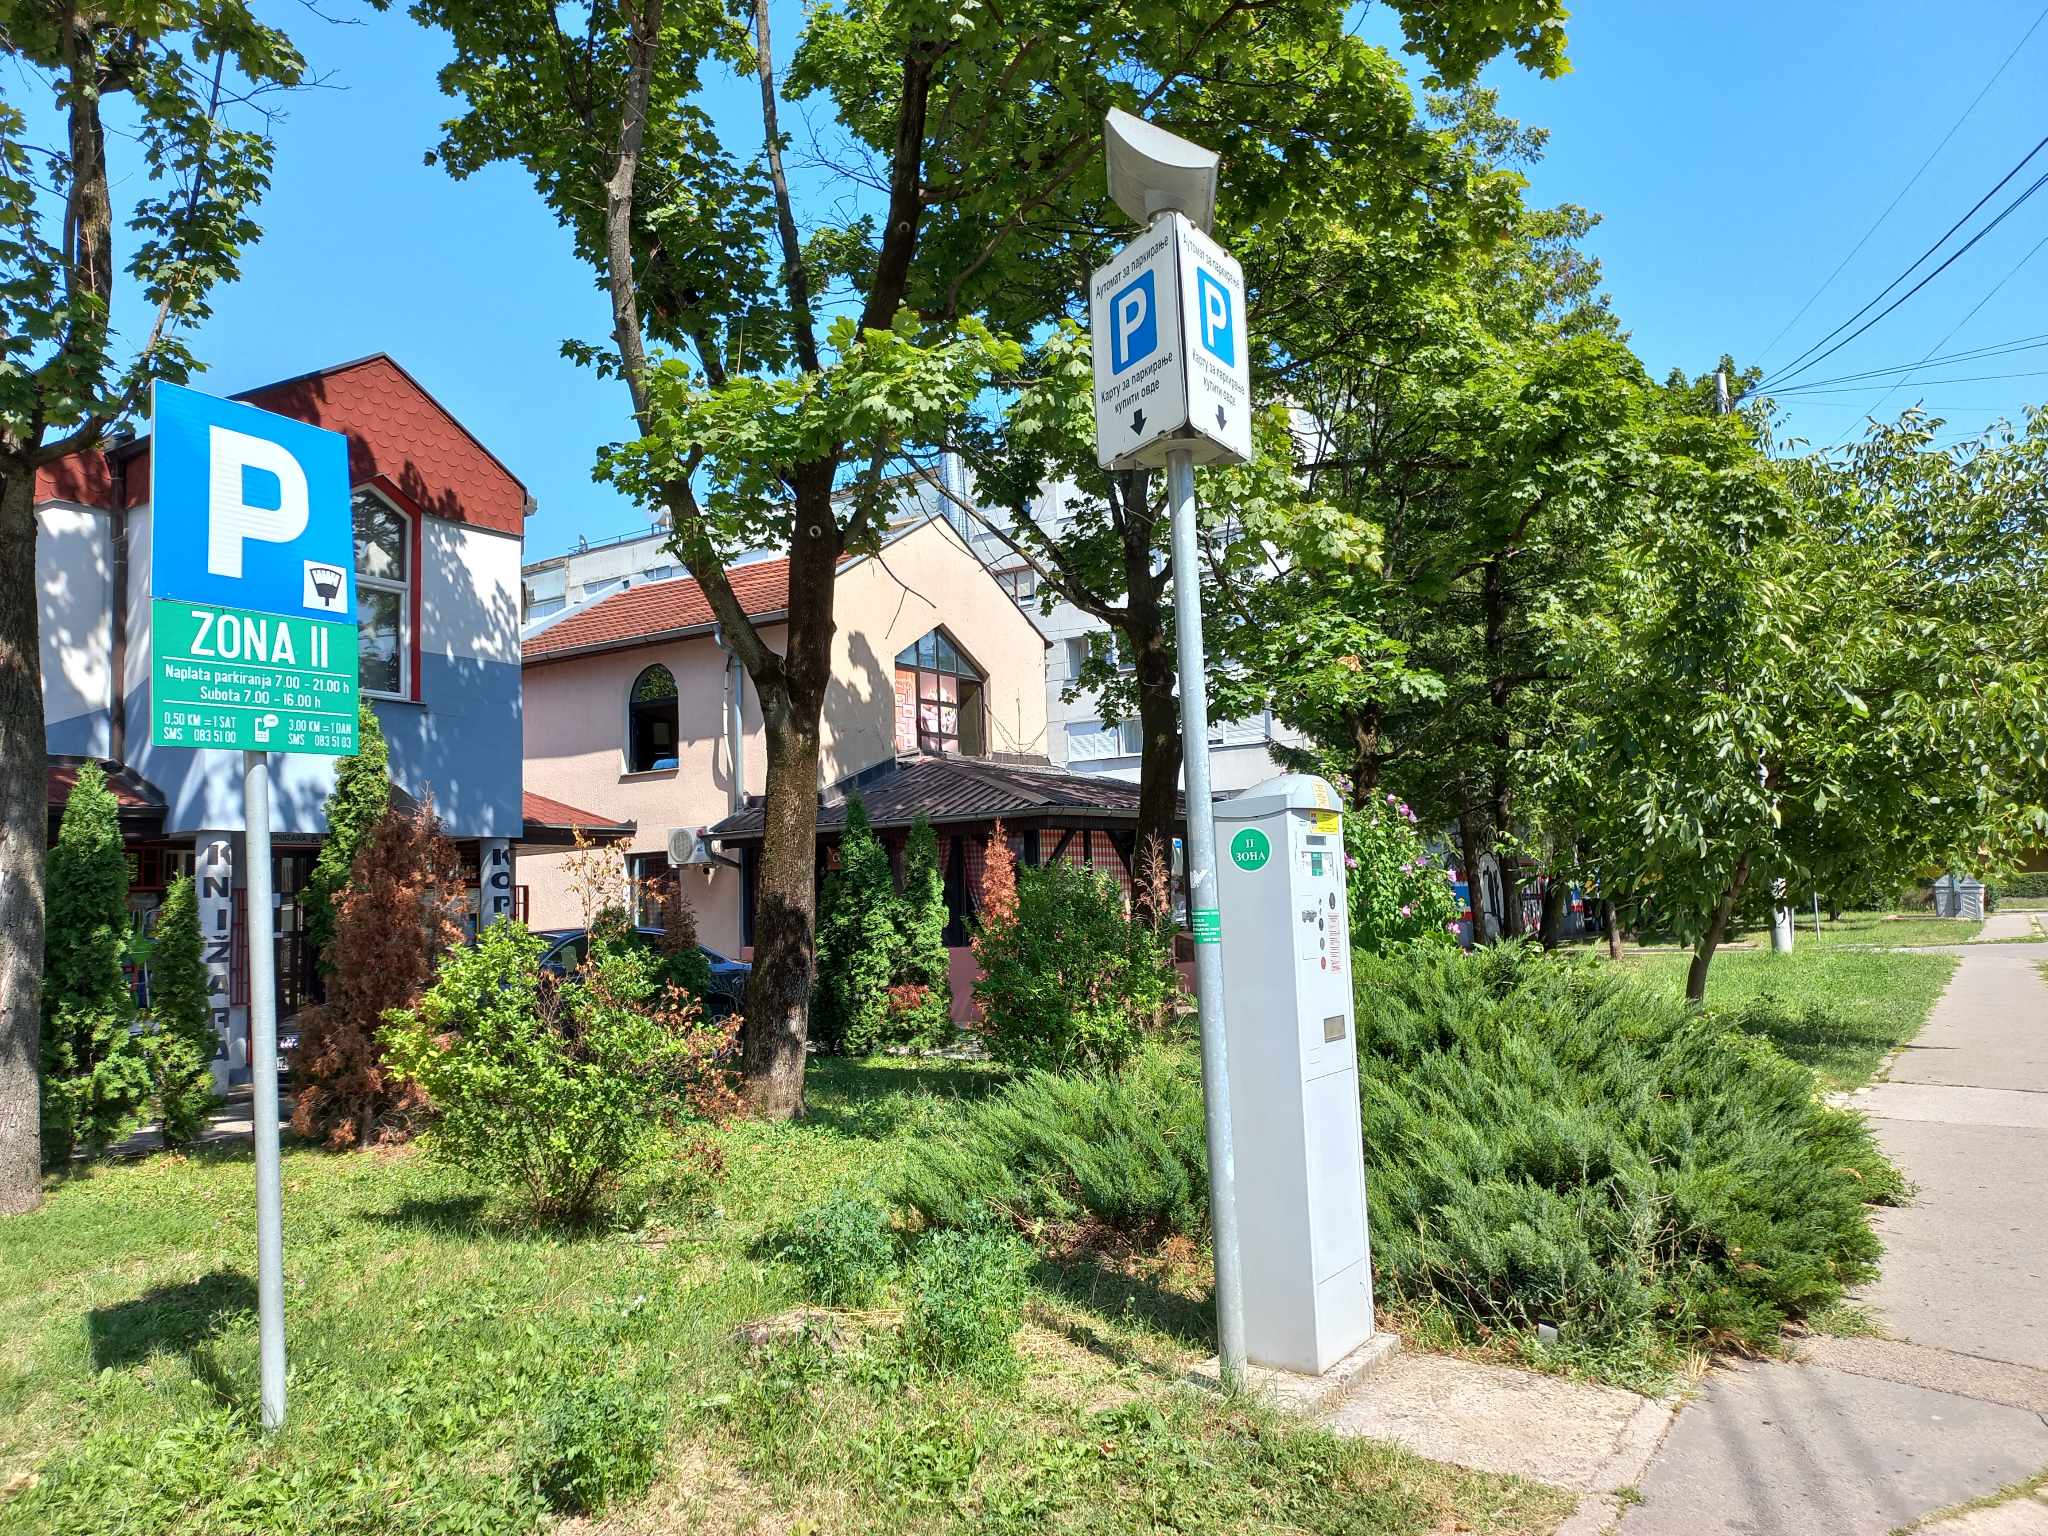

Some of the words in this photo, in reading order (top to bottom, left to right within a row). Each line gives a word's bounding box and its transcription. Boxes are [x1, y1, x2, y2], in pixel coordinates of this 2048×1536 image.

[1096, 272, 1121, 299] Аутомат
[1122, 265, 1130, 279] за
[1131, 235, 1169, 272] паркирање
[1118, 287, 1147, 364] P
[1204, 279, 1227, 348] P
[1101, 385, 1121, 404] Карту
[1122, 378, 1130, 391] за
[1131, 352, 1173, 384] паркирање
[1115, 392, 1140, 414] купити
[1140, 379, 1160, 398] овде
[208, 425, 309, 579] P
[190, 610, 296, 665] ZONA
[310, 625, 329, 669] II
[165, 664, 211, 682] Naplata
[214, 670, 272, 689] parkiranja
[275, 674, 300, 689] 7.00
[312, 678, 340, 693] 21.00
[343, 681, 350, 694] h
[200, 687, 241, 702] Subota
[244, 690, 270, 705] 7.00
[283, 693, 312, 708] 16.00
[314, 695, 321, 709] h
[164, 712, 185, 725] 0.50
[187, 714, 200, 726] KM
[288, 720, 307, 732] 3.00
[308, 720, 321, 733] KM
[163, 727, 183, 741] SMS
[194, 729, 211, 743] 083
[213, 729, 223, 743] 51
[224, 731, 237, 744] 00
[288, 733, 305, 746] SMS
[314, 735, 330, 747] 083
[330, 735, 340, 748] 51
[1235, 850, 1266, 862] ЗОНА
